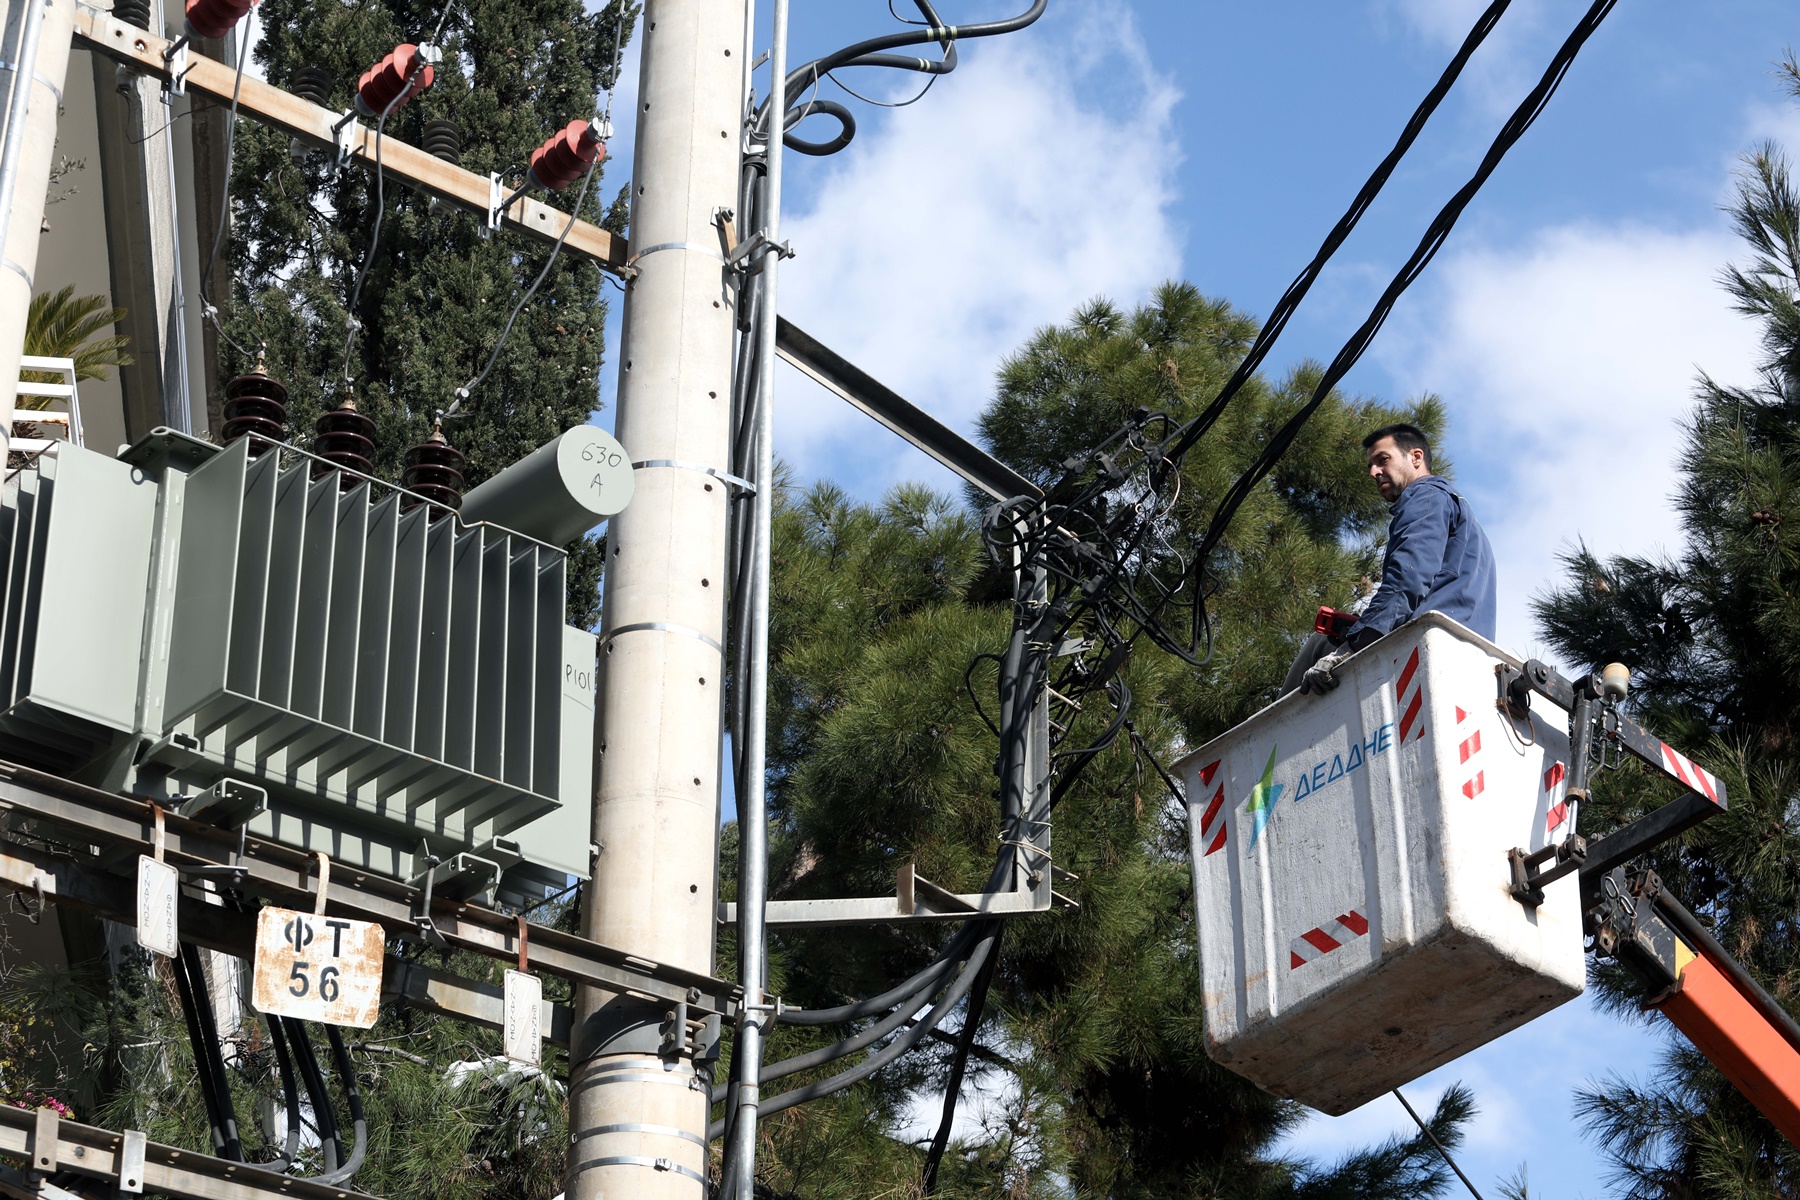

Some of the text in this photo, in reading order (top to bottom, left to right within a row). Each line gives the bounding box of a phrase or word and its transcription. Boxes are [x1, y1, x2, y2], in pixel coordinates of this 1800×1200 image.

[581, 442, 622, 468] 630
[590, 472, 604, 497] A
[1293, 722, 1394, 803] ΔΕΔΔΗΕ
[143, 864, 151, 928] ΚΙΝΔΥΝΟΣ
[288, 961, 340, 1003] 56
